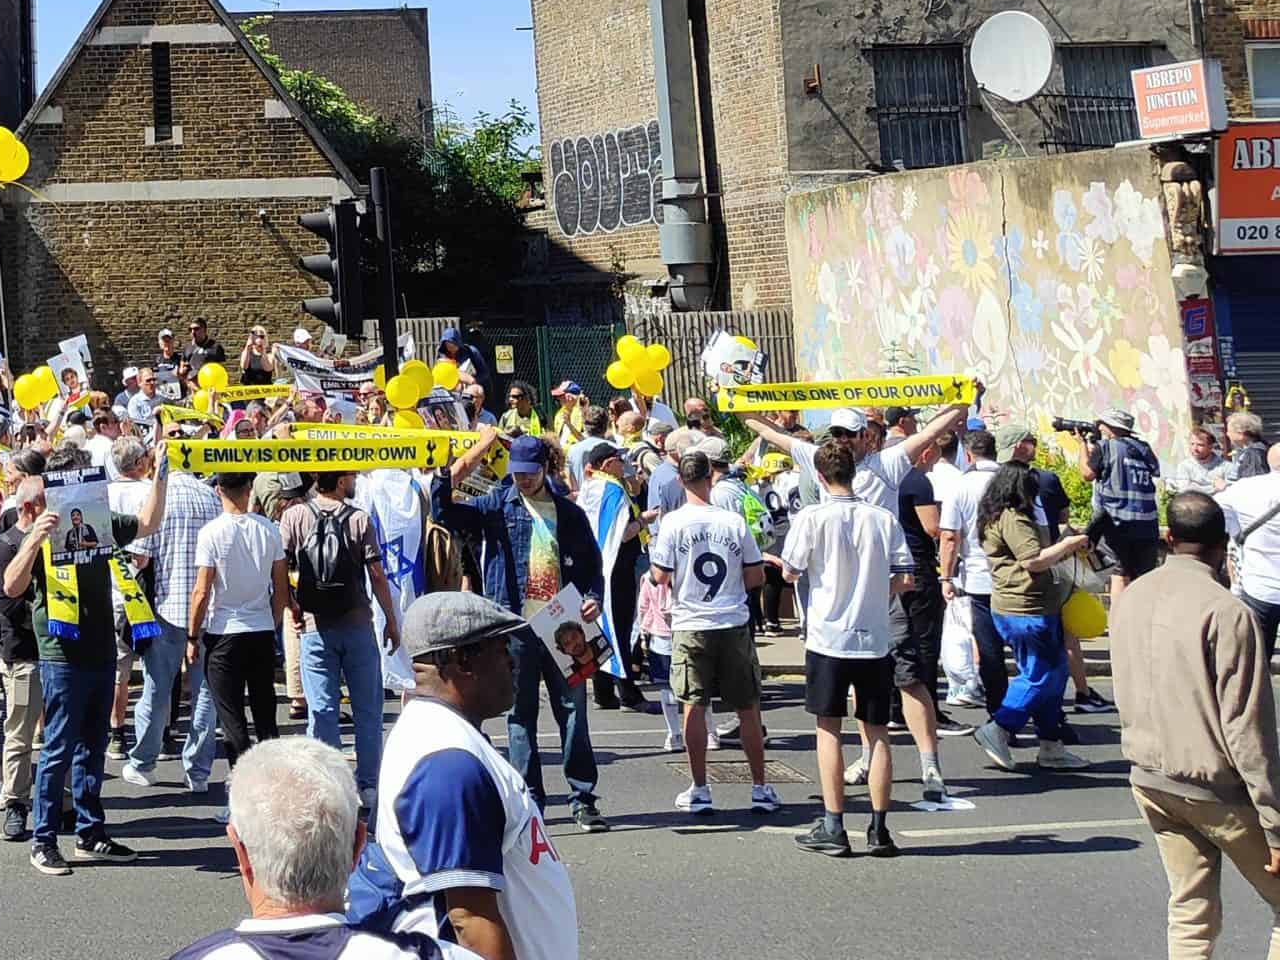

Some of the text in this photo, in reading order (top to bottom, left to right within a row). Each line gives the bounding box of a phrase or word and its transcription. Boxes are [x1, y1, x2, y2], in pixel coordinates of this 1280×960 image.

[1145, 67, 1193, 90] ABREPO
[1146, 88, 1198, 113] JUNCTION
[1143, 110, 1205, 130] Supermarket
[1236, 224, 1269, 241] 020
[746, 383, 943, 404] EMILY IS ONE OF OUR OWN
[203, 446, 417, 463] EMILY IS ONE OF OUR OWN
[47, 469, 80, 481] WELCOME
[678, 529, 742, 558] RICHARLISON
[693, 551, 727, 602] 9
[529, 816, 560, 865] A
